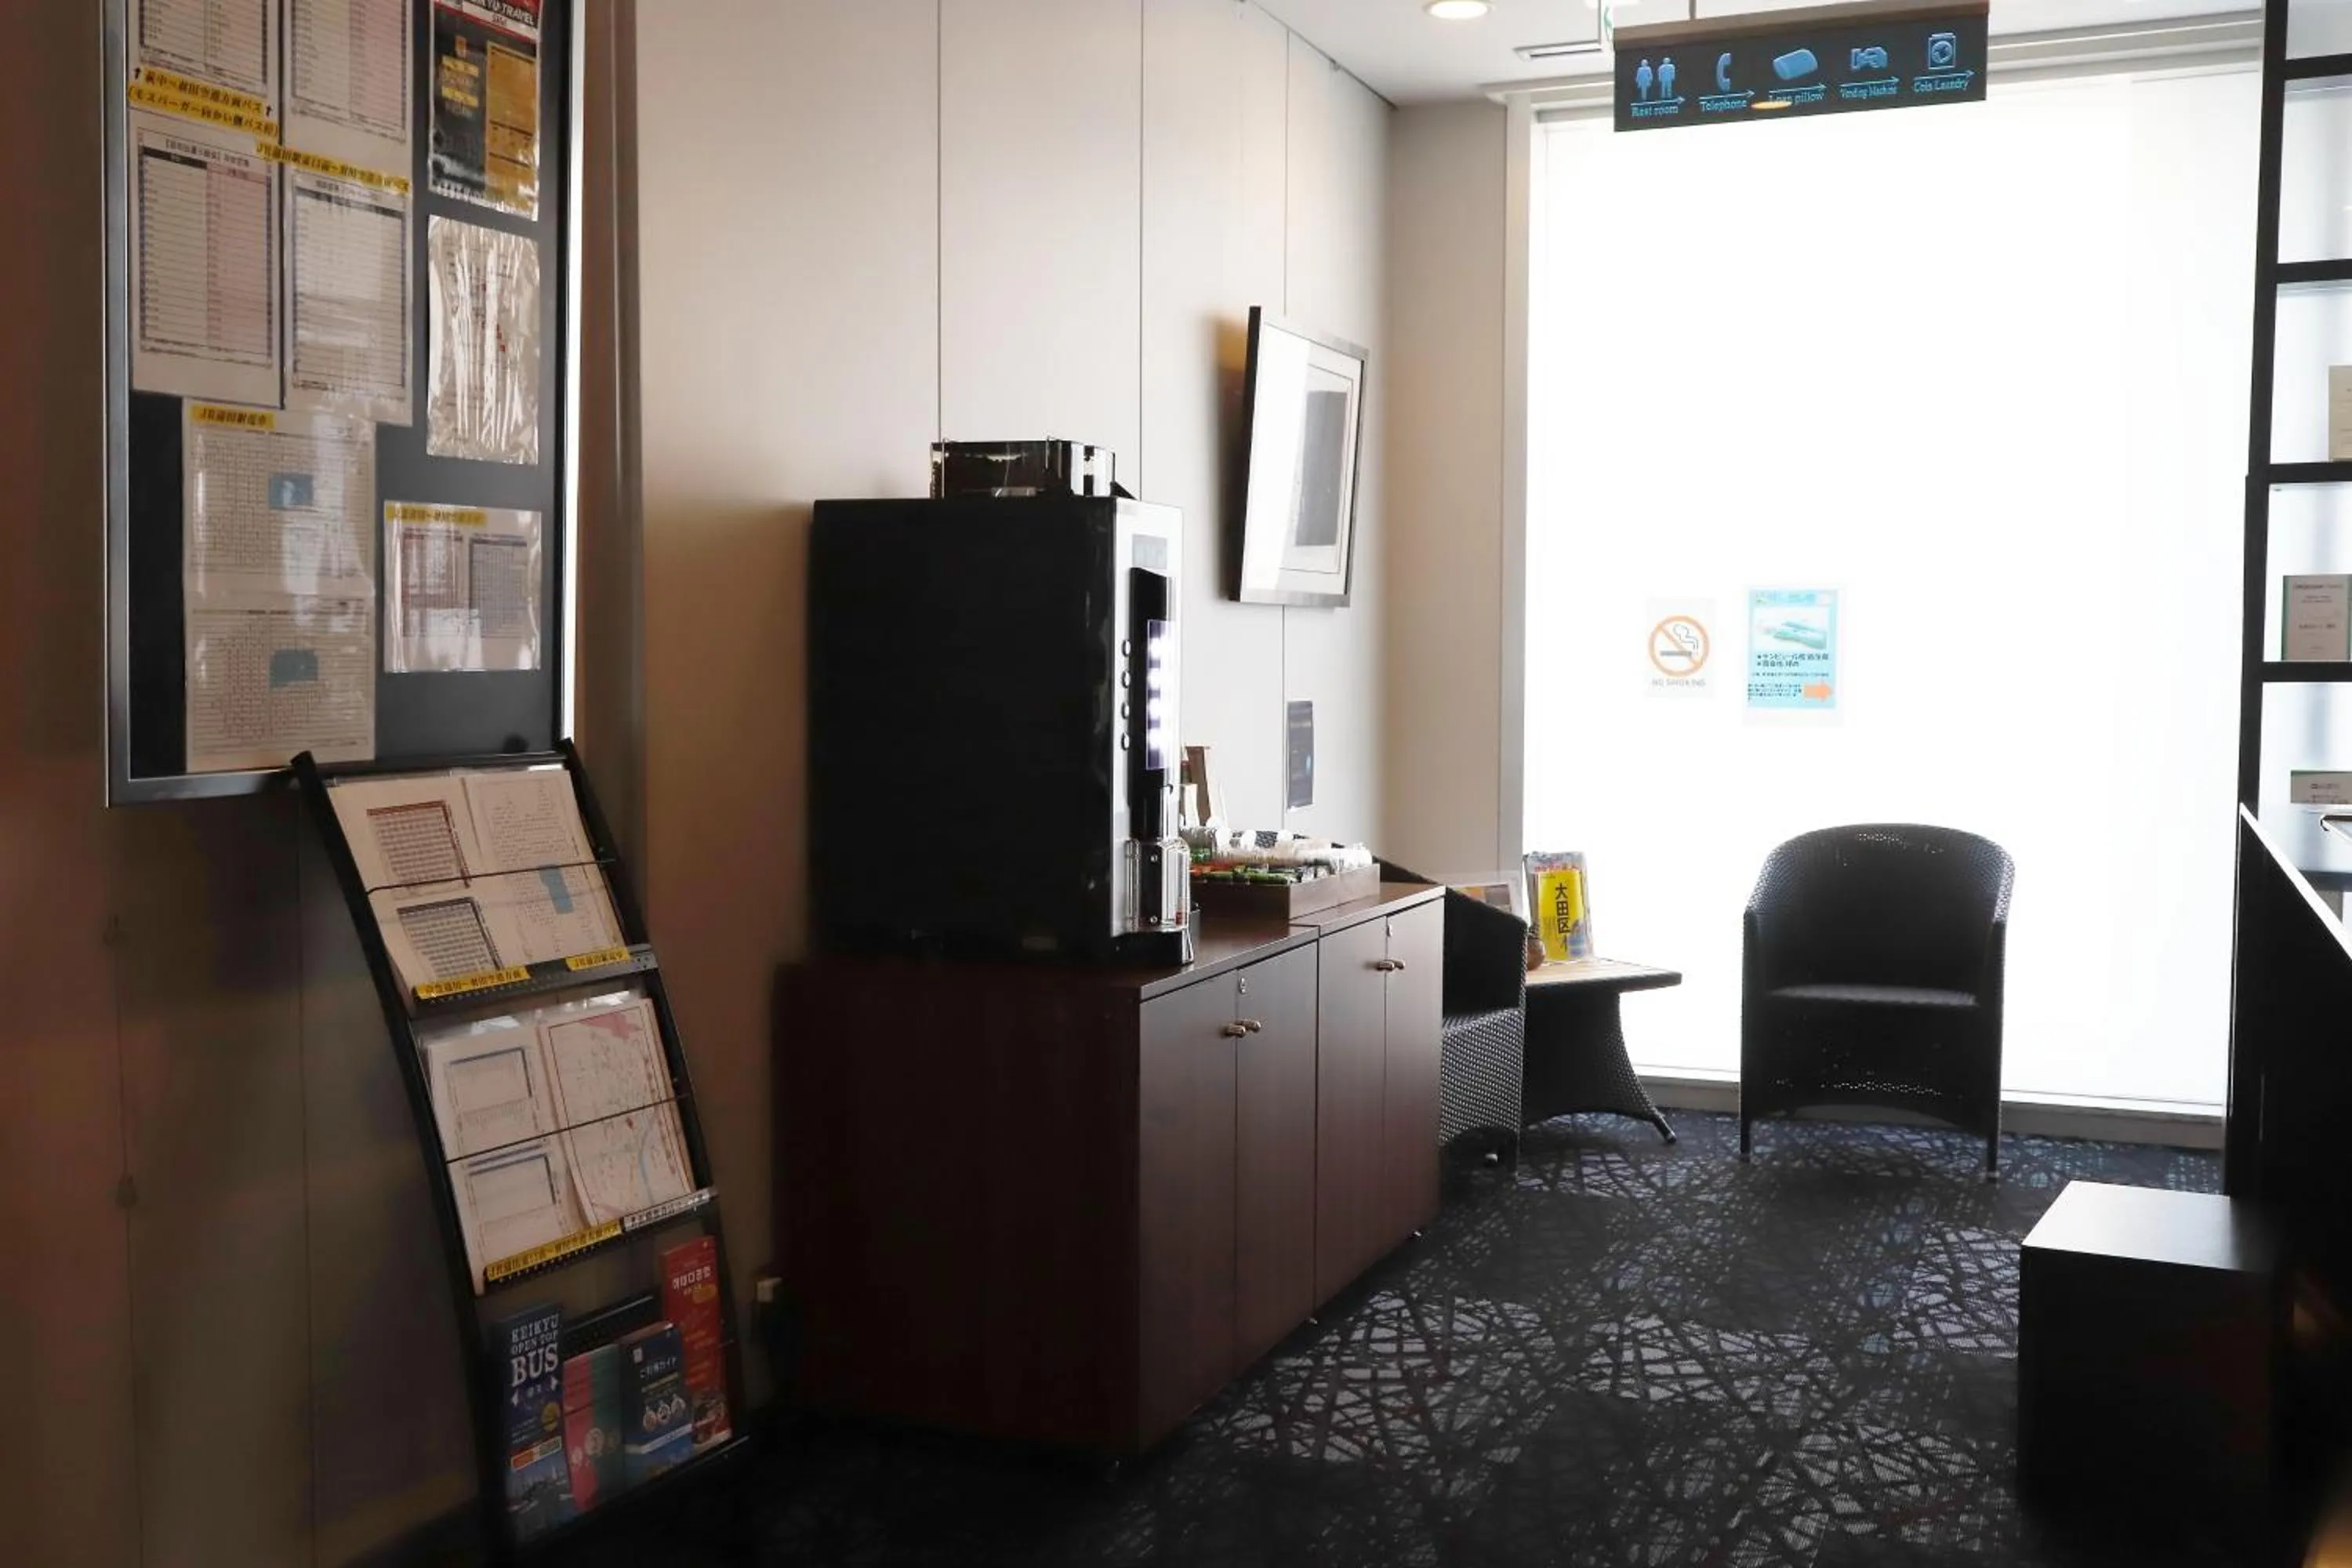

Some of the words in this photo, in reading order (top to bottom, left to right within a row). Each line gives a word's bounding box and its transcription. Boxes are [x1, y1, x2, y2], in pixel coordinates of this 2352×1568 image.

[501, 3, 535, 25] TRAVEL
[1935, 79, 1970, 92] Laundry
[1795, 91, 1825, 104] pillow
[1632, 107, 1652, 117] Rest
[1653, 105, 1679, 115] room
[1700, 100, 1748, 113] Telephone
[1652, 678, 1664, 687] NO
[1666, 677, 1706, 687] SMOKING
[1555, 882, 1570, 934] 大田区
[510, 1313, 559, 1342] KEIKYU
[510, 1336, 538, 1356] OPEN
[540, 1330, 559, 1345] TOP
[510, 1342, 560, 1387] BUS
